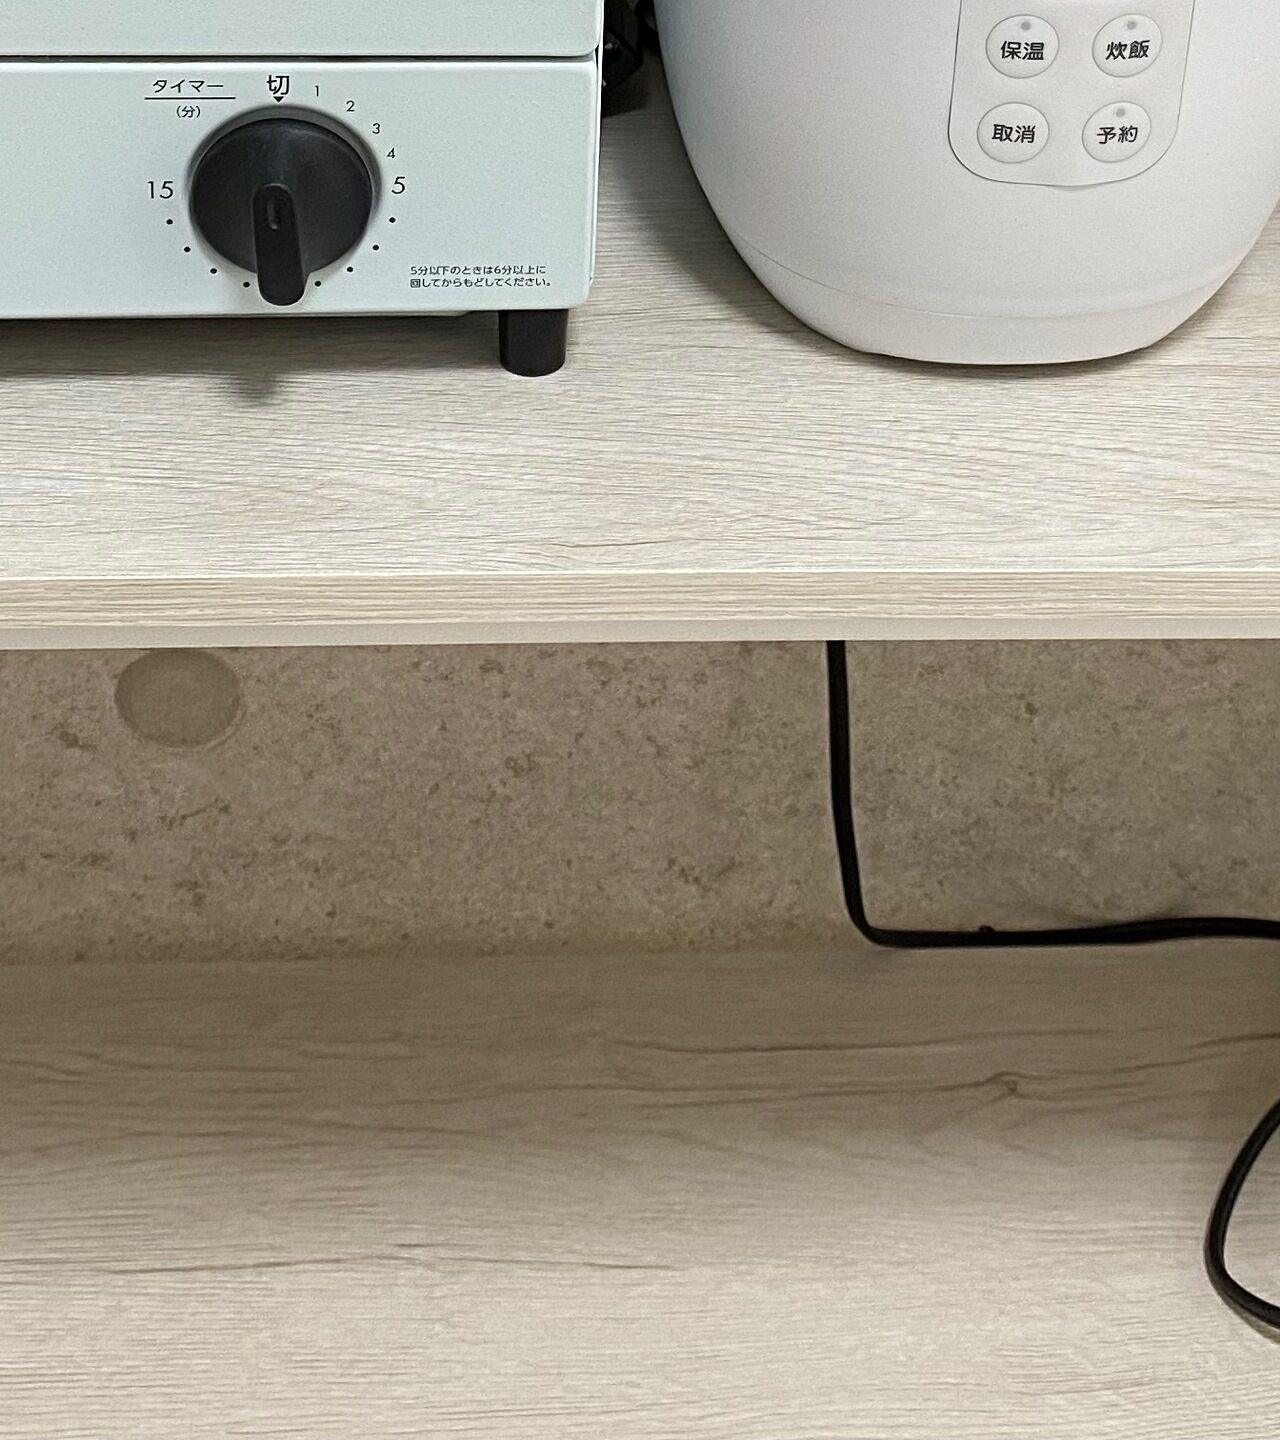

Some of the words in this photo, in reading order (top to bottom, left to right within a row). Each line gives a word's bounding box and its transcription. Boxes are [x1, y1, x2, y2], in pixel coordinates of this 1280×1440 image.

[1000, 40, 1045, 61] 保温
[1105, 40, 1151, 61] 炊飯
[152, 78, 225, 94] タイマー
[266, 74, 290, 96] 切
[314, 84, 320, 97] 1
[346, 100, 355, 112] 2
[372, 122, 381, 135] 3
[991, 124, 1036, 144] 取消
[1096, 125, 1139, 145] 予約
[386, 147, 396, 160] 4
[147, 180, 174, 200] 15
[391, 176, 406, 195] 5
[410, 265, 546, 276] 5分以下のときは6分以上に
